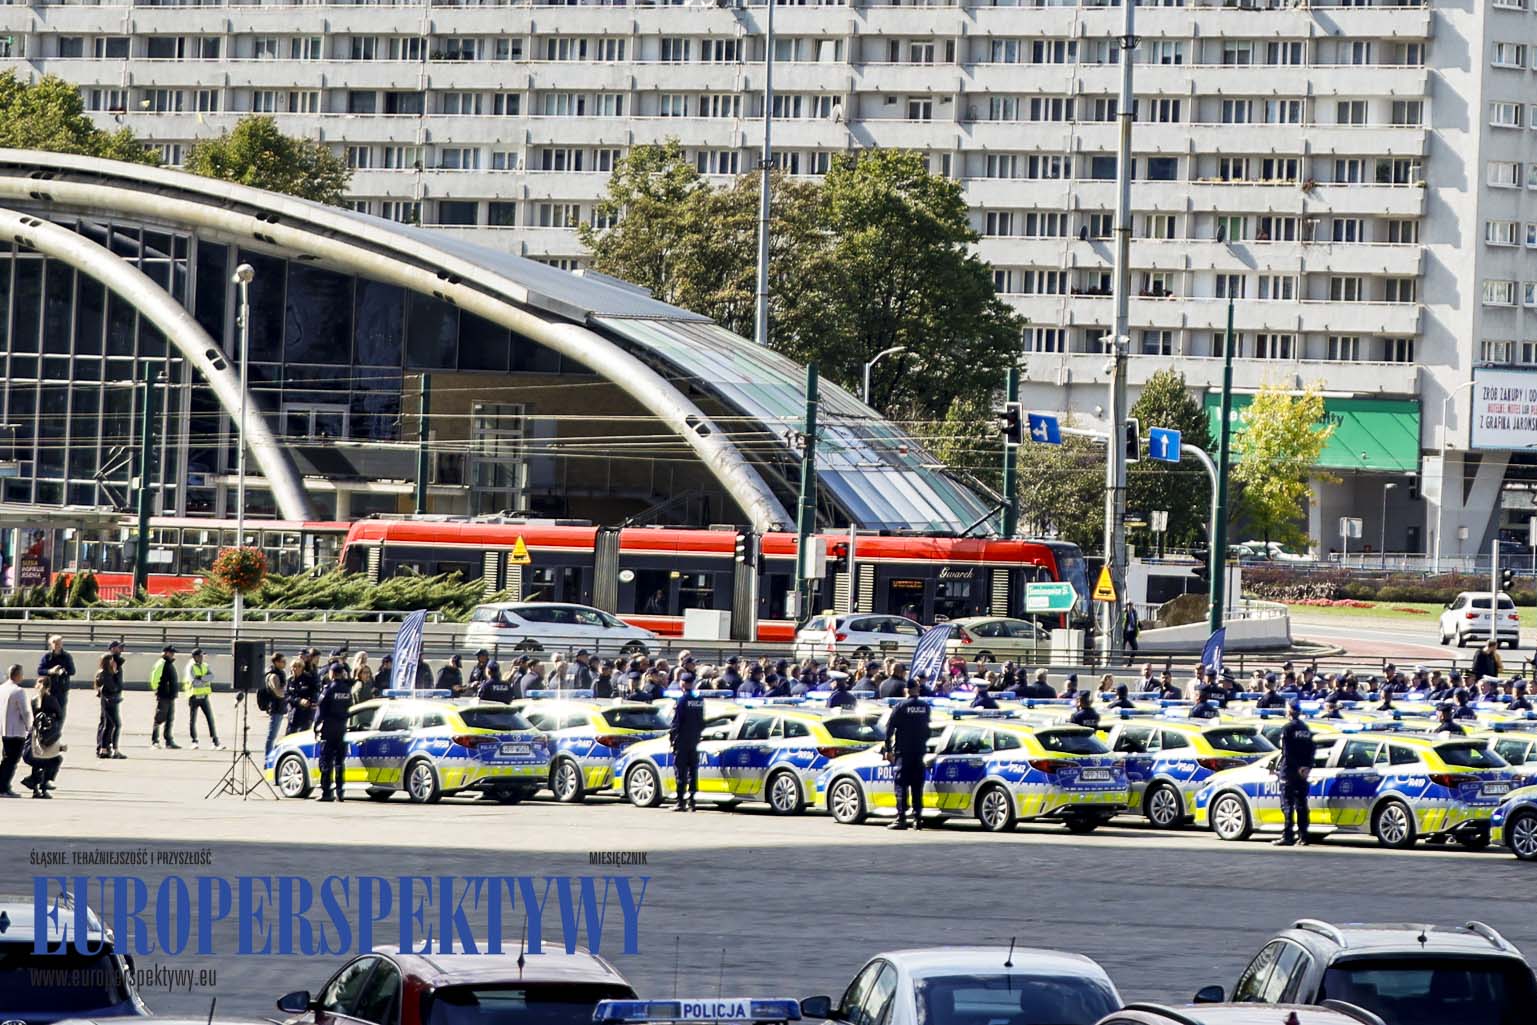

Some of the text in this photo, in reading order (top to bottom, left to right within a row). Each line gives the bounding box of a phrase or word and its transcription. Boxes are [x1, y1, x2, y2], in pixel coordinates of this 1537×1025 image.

[1483, 385, 1498, 400] ZRÓB
[1500, 387, 1523, 401] ZAKUPY
[940, 567, 974, 578] Gwarek
[684, 1004, 746, 1018] POLICJA
